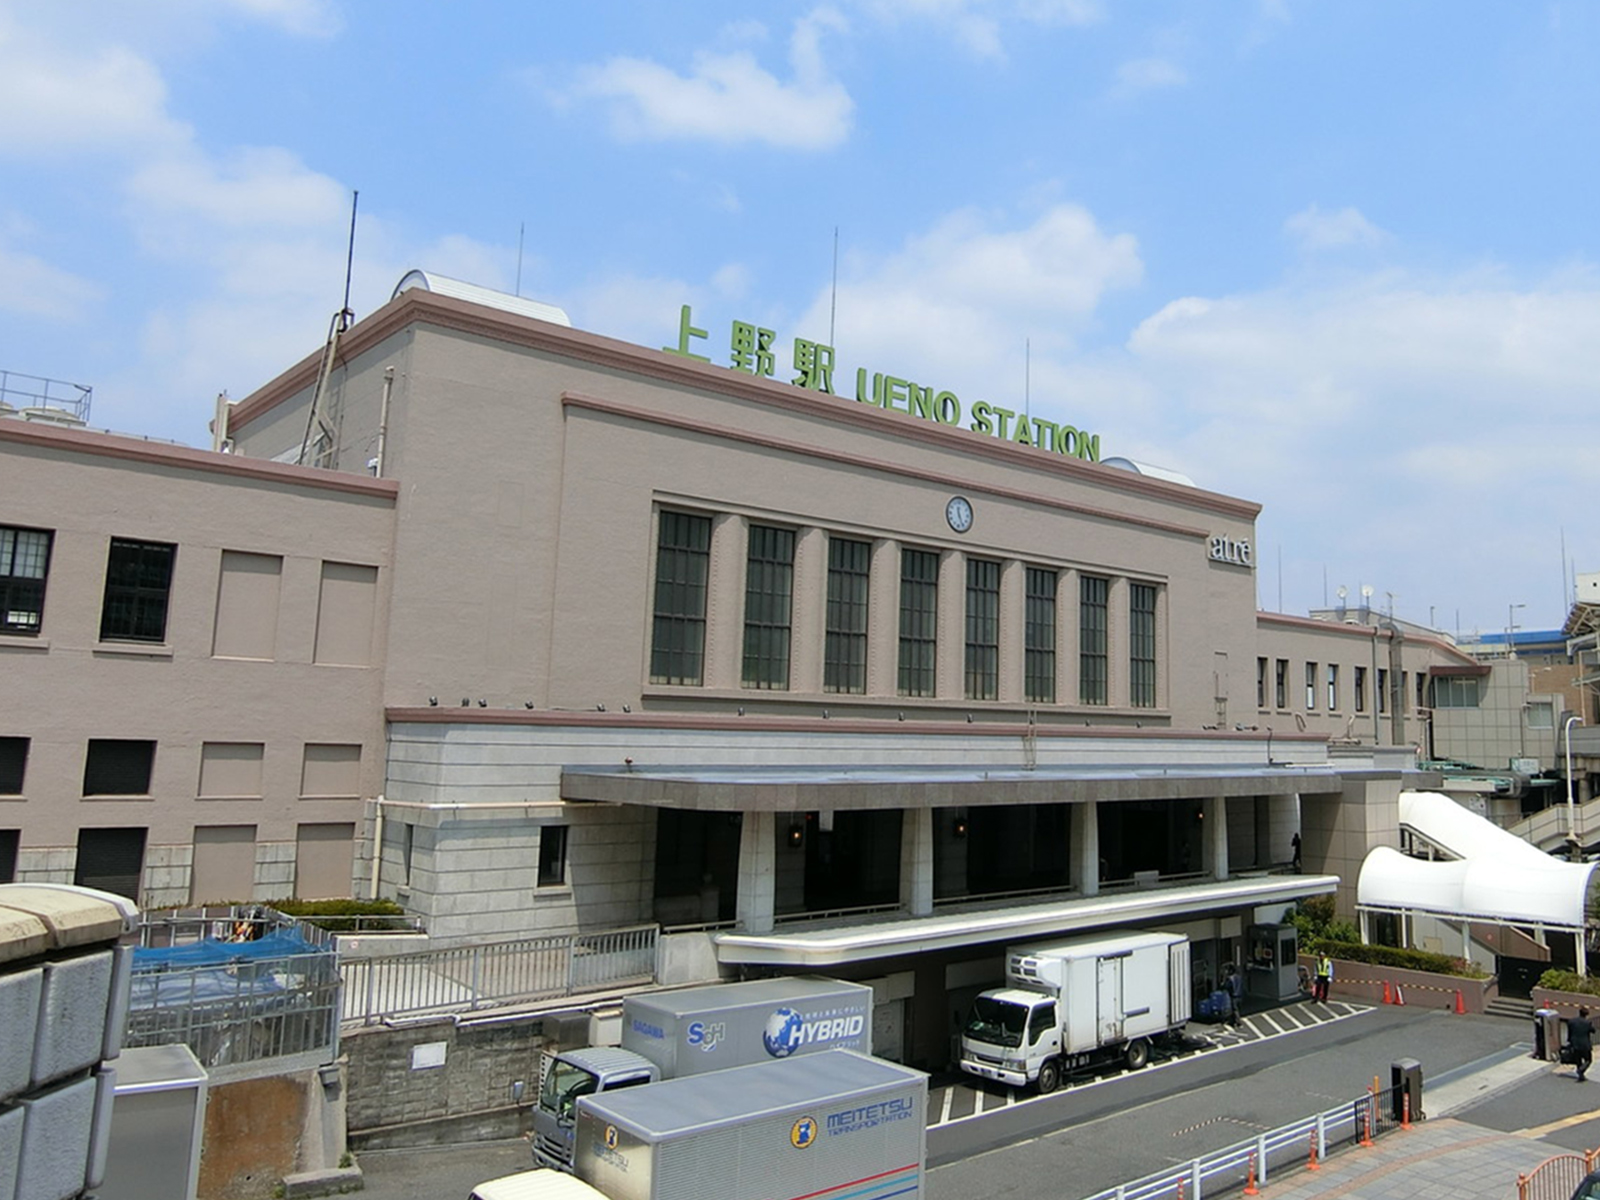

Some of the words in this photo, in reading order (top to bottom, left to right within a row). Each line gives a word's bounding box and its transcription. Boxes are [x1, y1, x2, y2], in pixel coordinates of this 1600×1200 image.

[662, 304, 835, 395] 上野駅
[857, 367, 961, 427] UENO
[971, 401, 1100, 462] STATION
[1210, 533, 1251, 564] atré
[788, 1015, 864, 1046] HYBRID
[827, 1097, 913, 1128] MEITETSU
[828, 1110, 912, 1137] TRANSPORTATION
